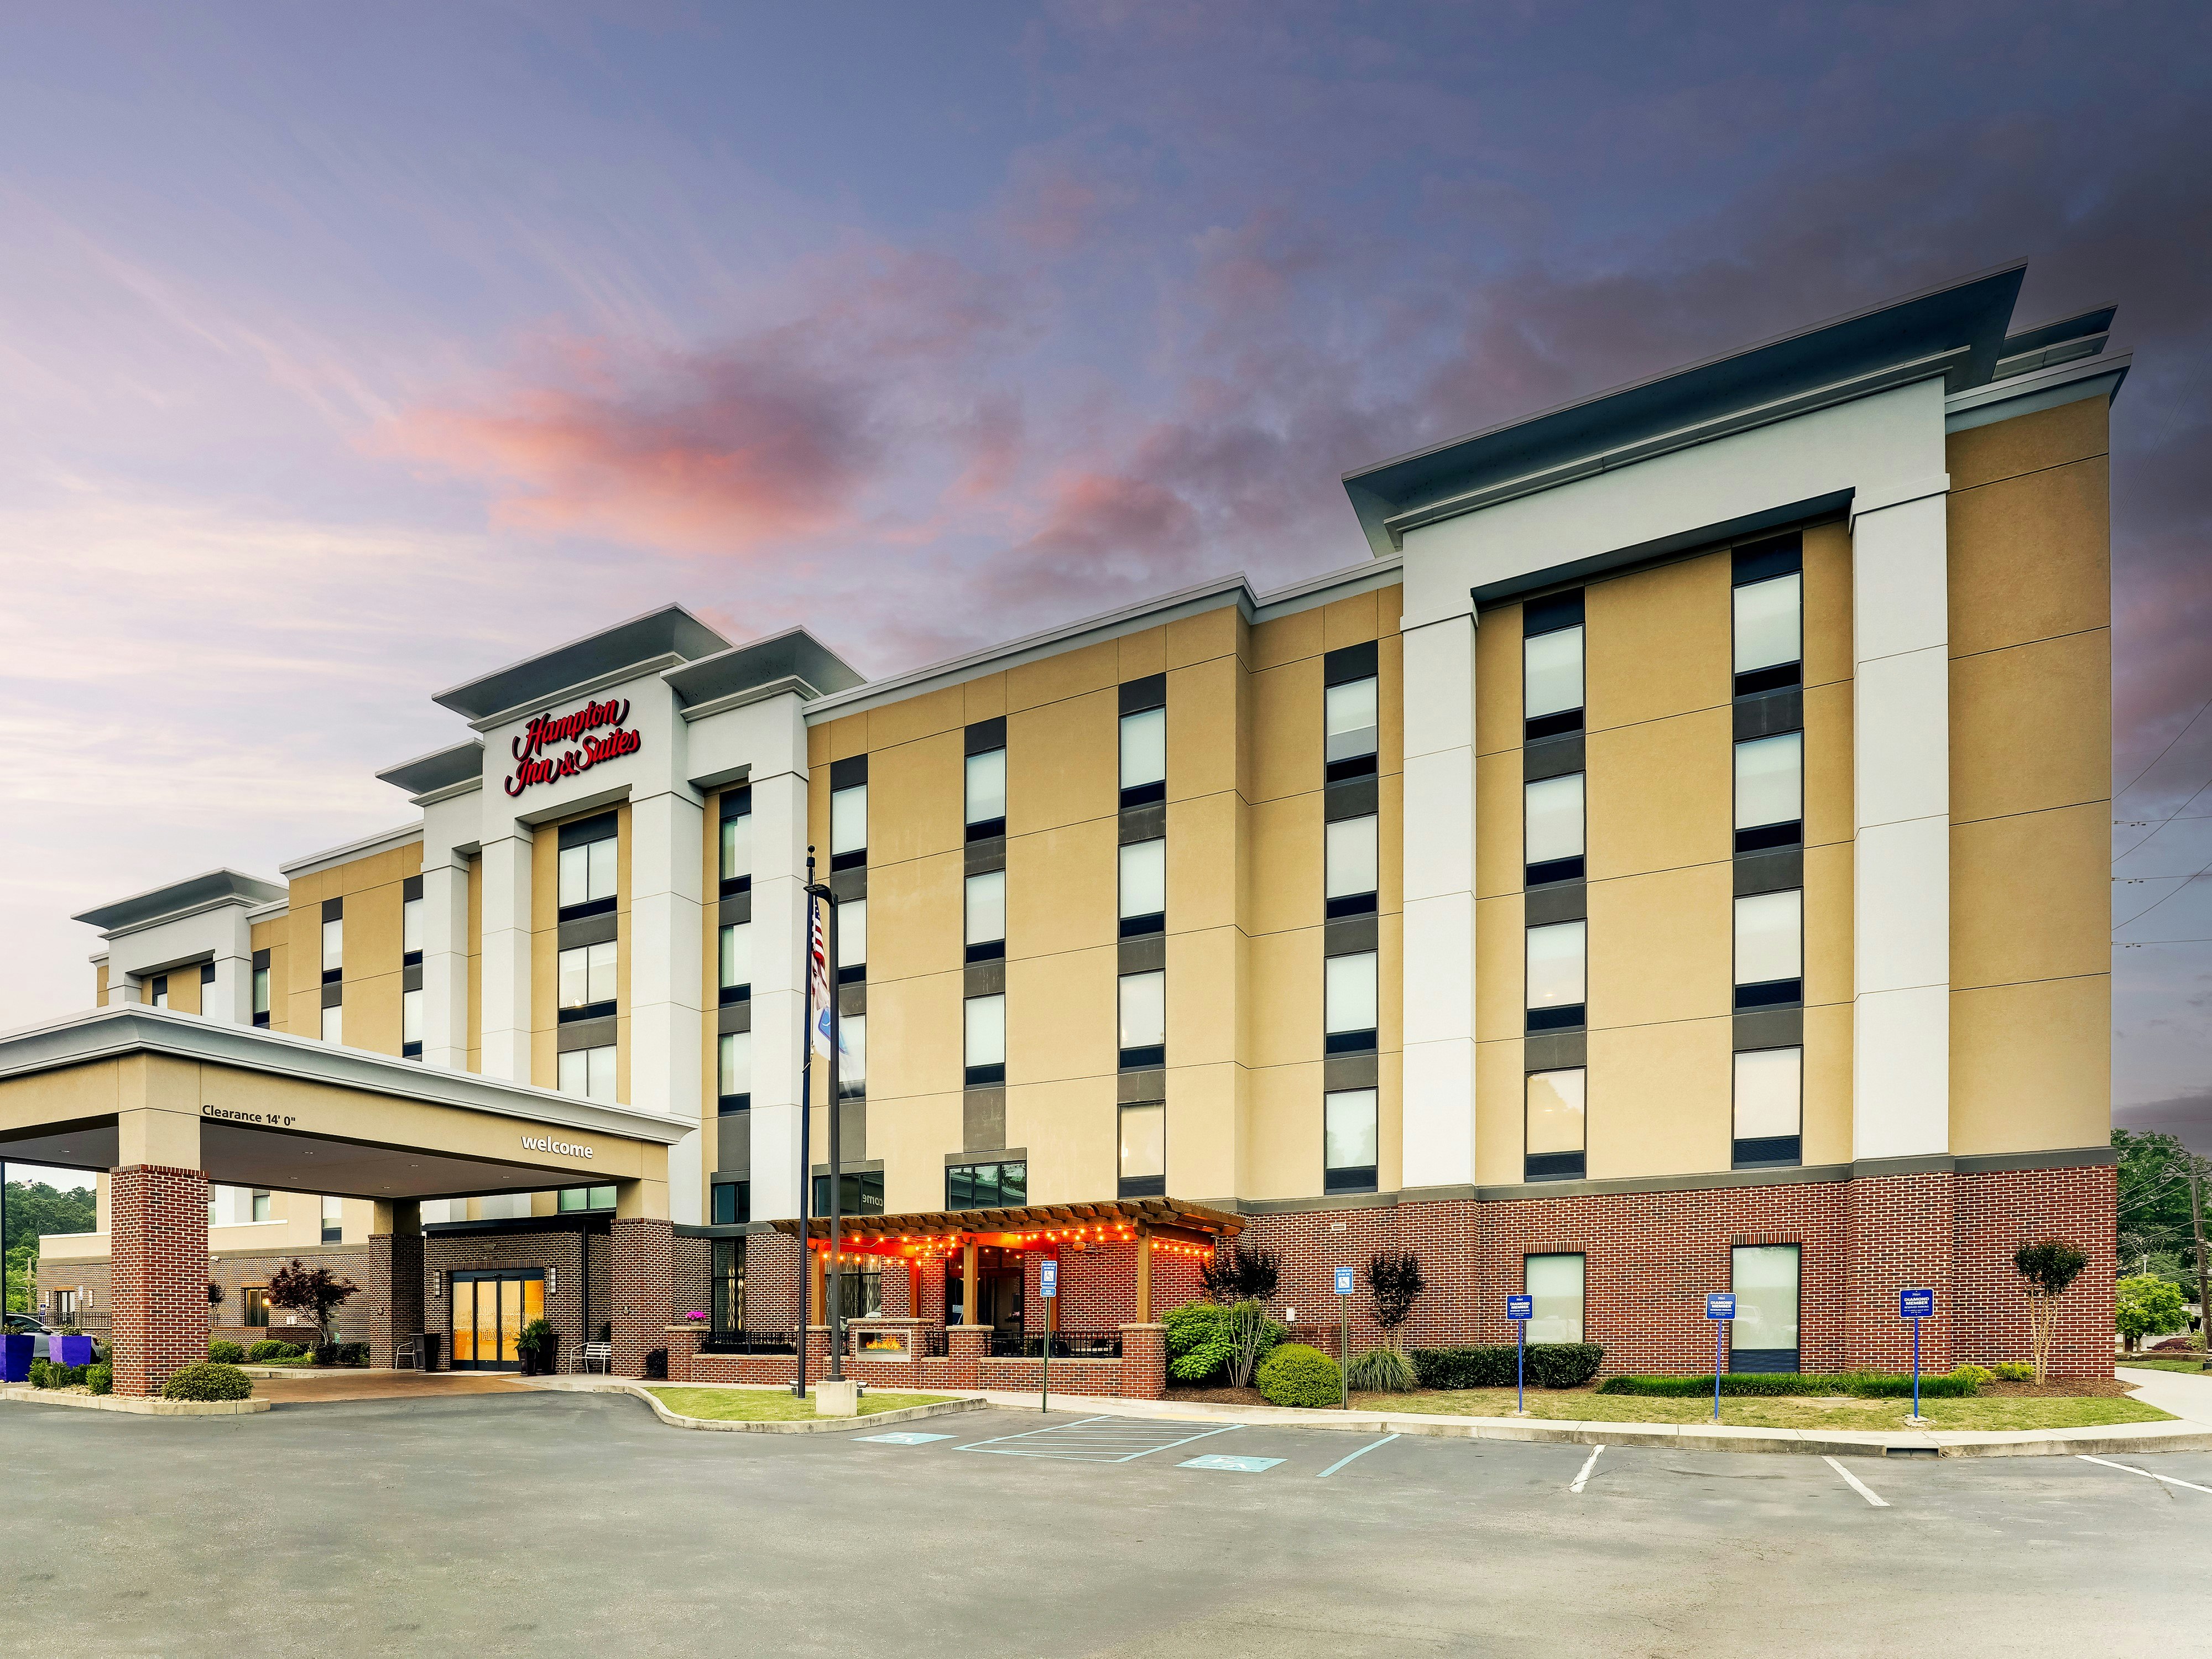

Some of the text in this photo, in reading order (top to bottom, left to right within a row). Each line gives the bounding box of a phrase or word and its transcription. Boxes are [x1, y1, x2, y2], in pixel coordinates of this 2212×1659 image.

[512, 698, 630, 762] Hampton
[504, 727, 641, 797] Inn & Suites
[202, 1105, 296, 1126] Clearance 14' 0"
[521, 1135, 593, 1159] welcome
[478, 1306, 520, 1315] MAING
[482, 1331, 515, 1340] HAPY
